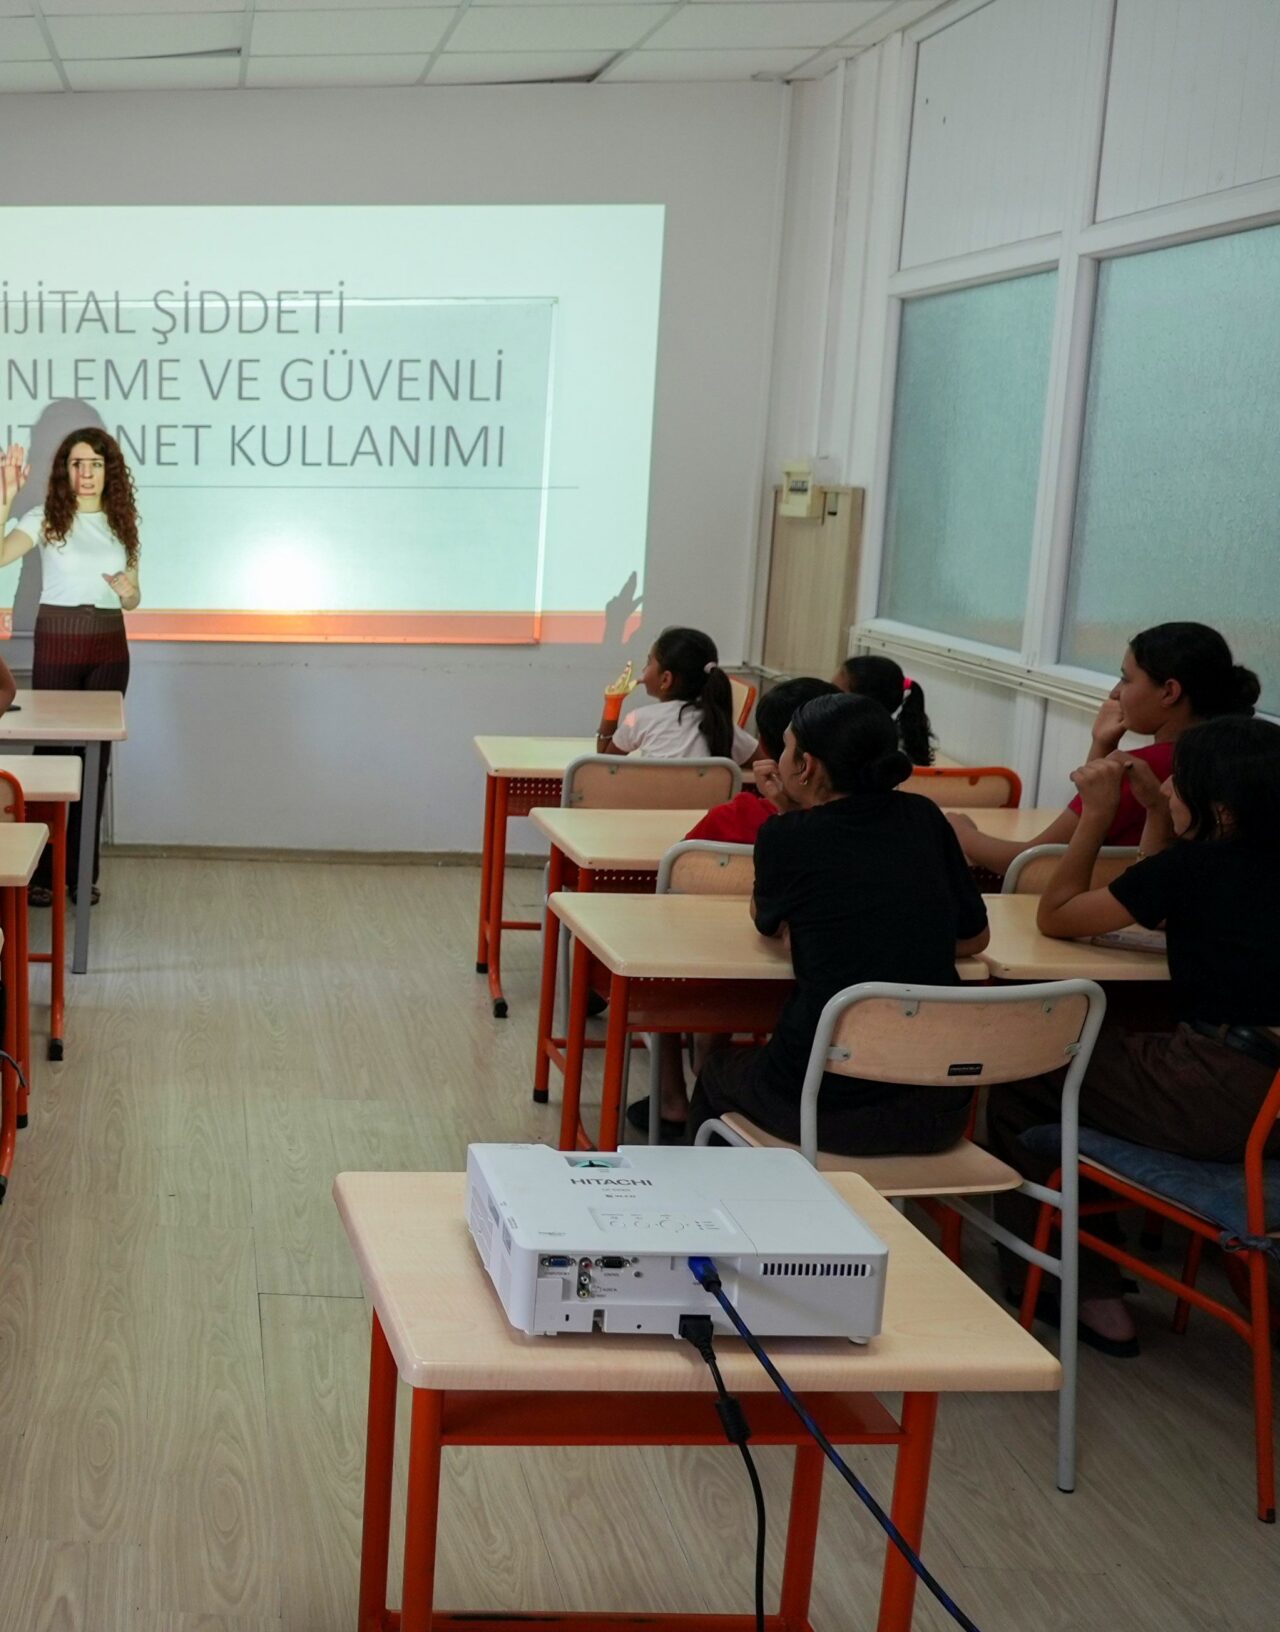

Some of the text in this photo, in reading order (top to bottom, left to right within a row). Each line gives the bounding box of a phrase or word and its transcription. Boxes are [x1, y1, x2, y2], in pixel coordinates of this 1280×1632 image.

[151, 280, 345, 345] ŞİDDETİ
[198, 358, 261, 401] VE
[280, 348, 504, 402] GÜVENLİ
[230, 424, 505, 468] KULLANIMI
[570, 1178, 653, 1186] HITACHI
